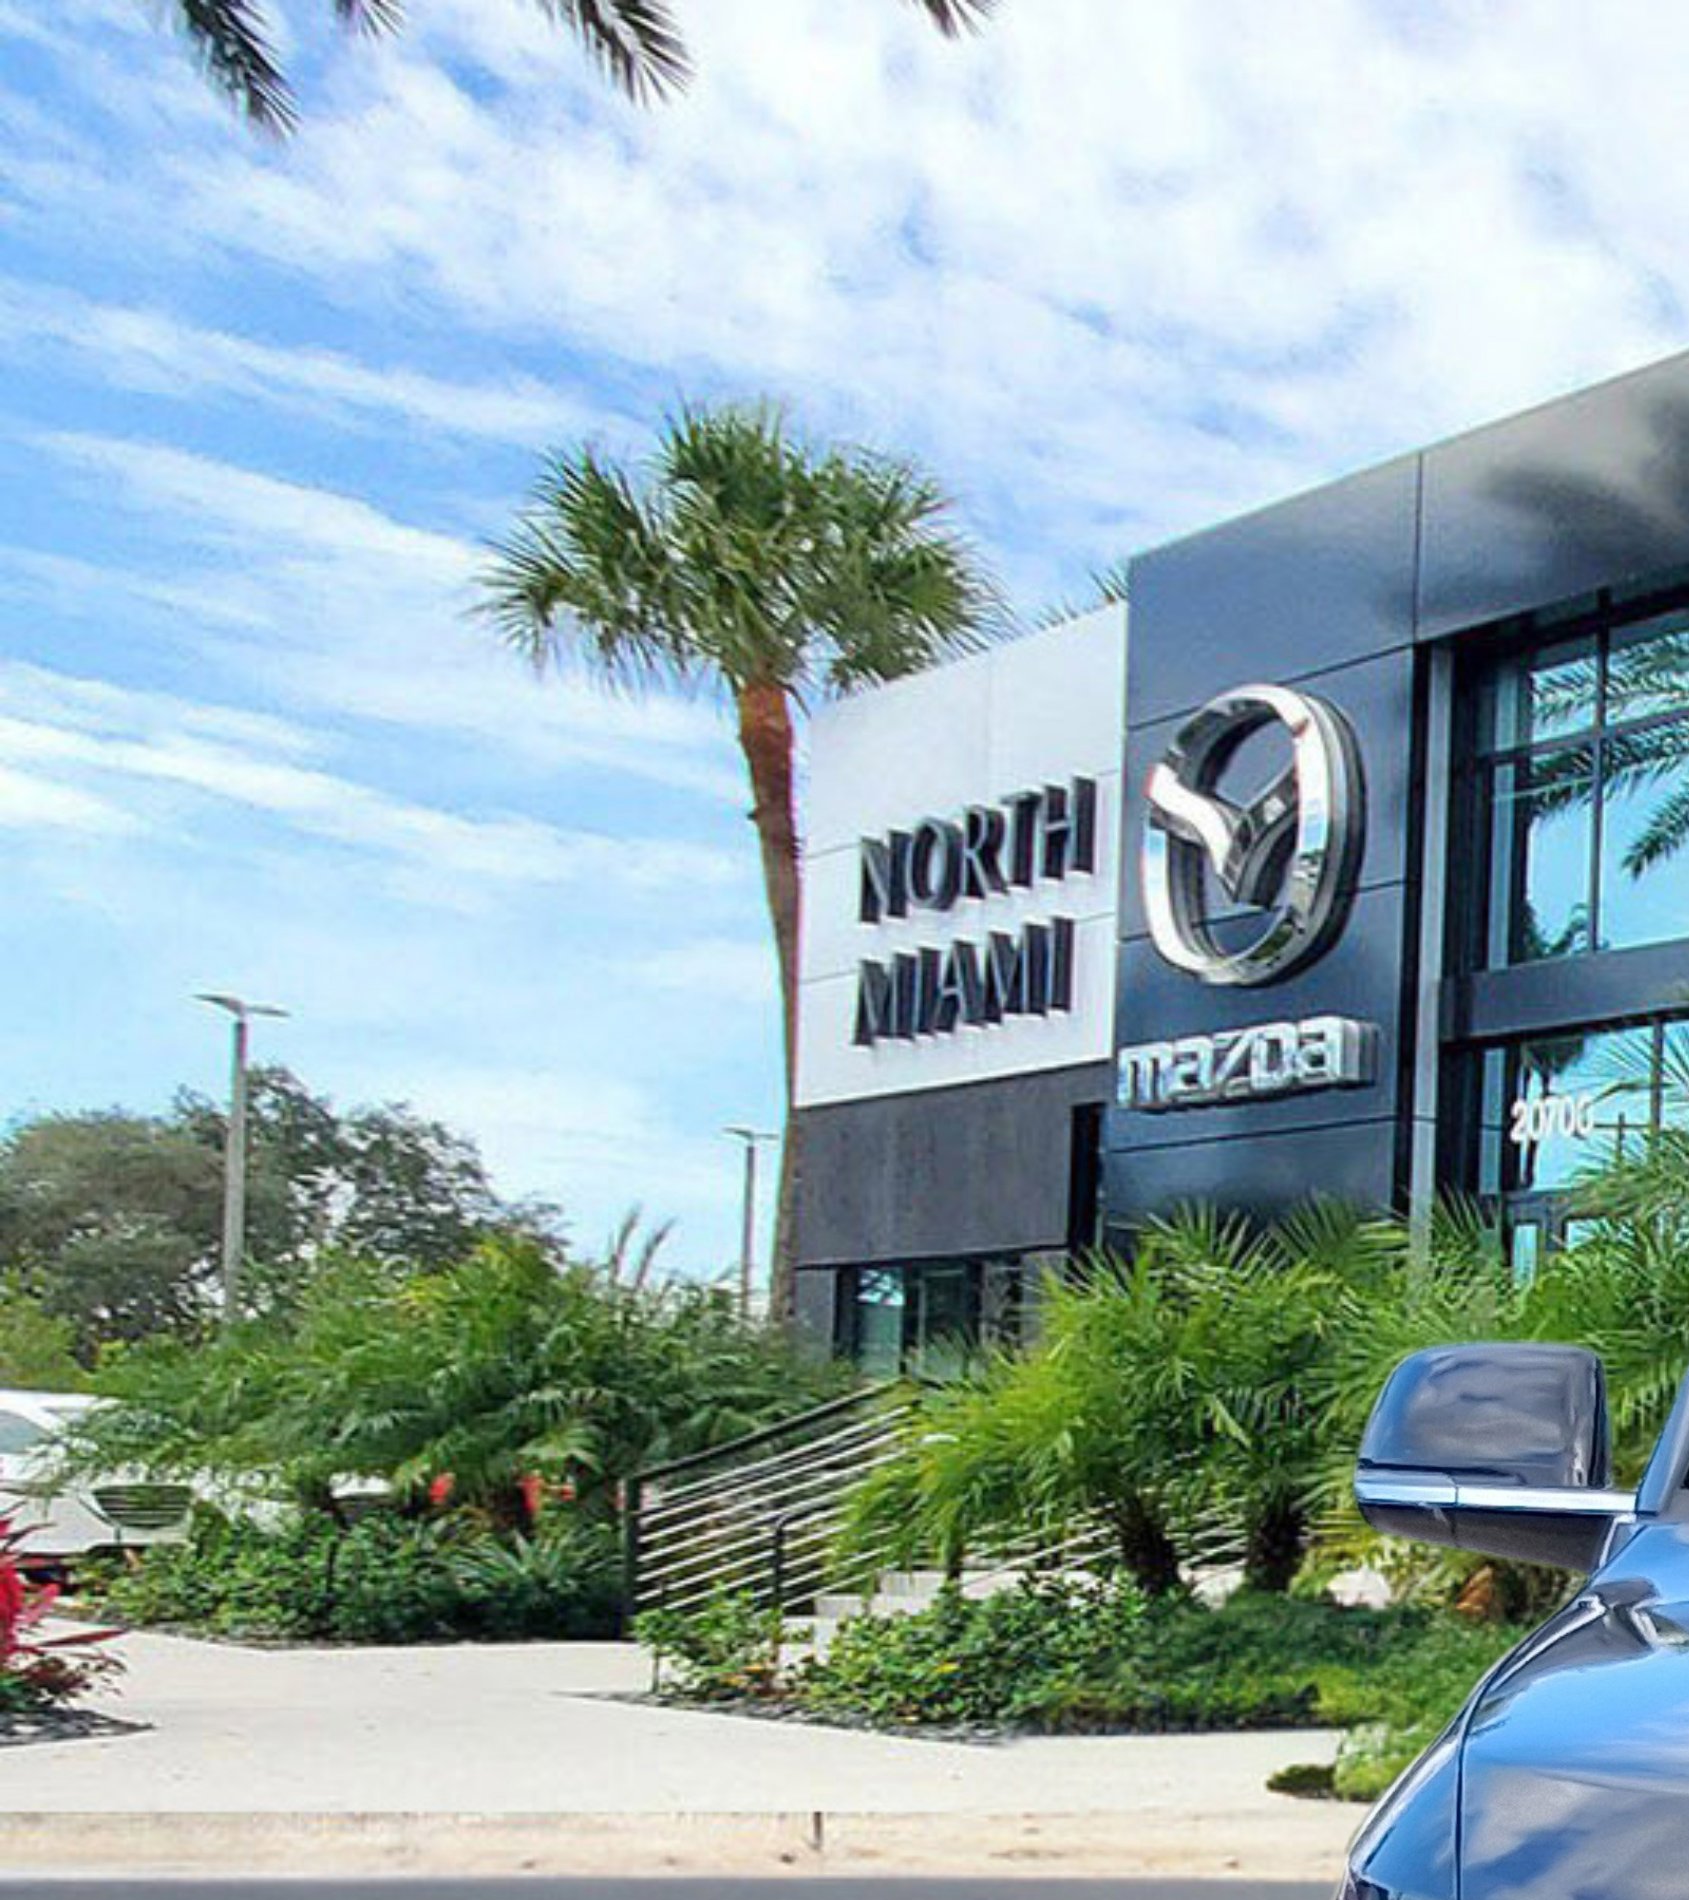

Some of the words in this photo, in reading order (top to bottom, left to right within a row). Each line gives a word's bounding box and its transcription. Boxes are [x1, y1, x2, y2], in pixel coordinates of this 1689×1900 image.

[860, 776, 1097, 924] NORTH
[853, 916, 1076, 1047] MIAMI
[1117, 1014, 1374, 1112] mazda
